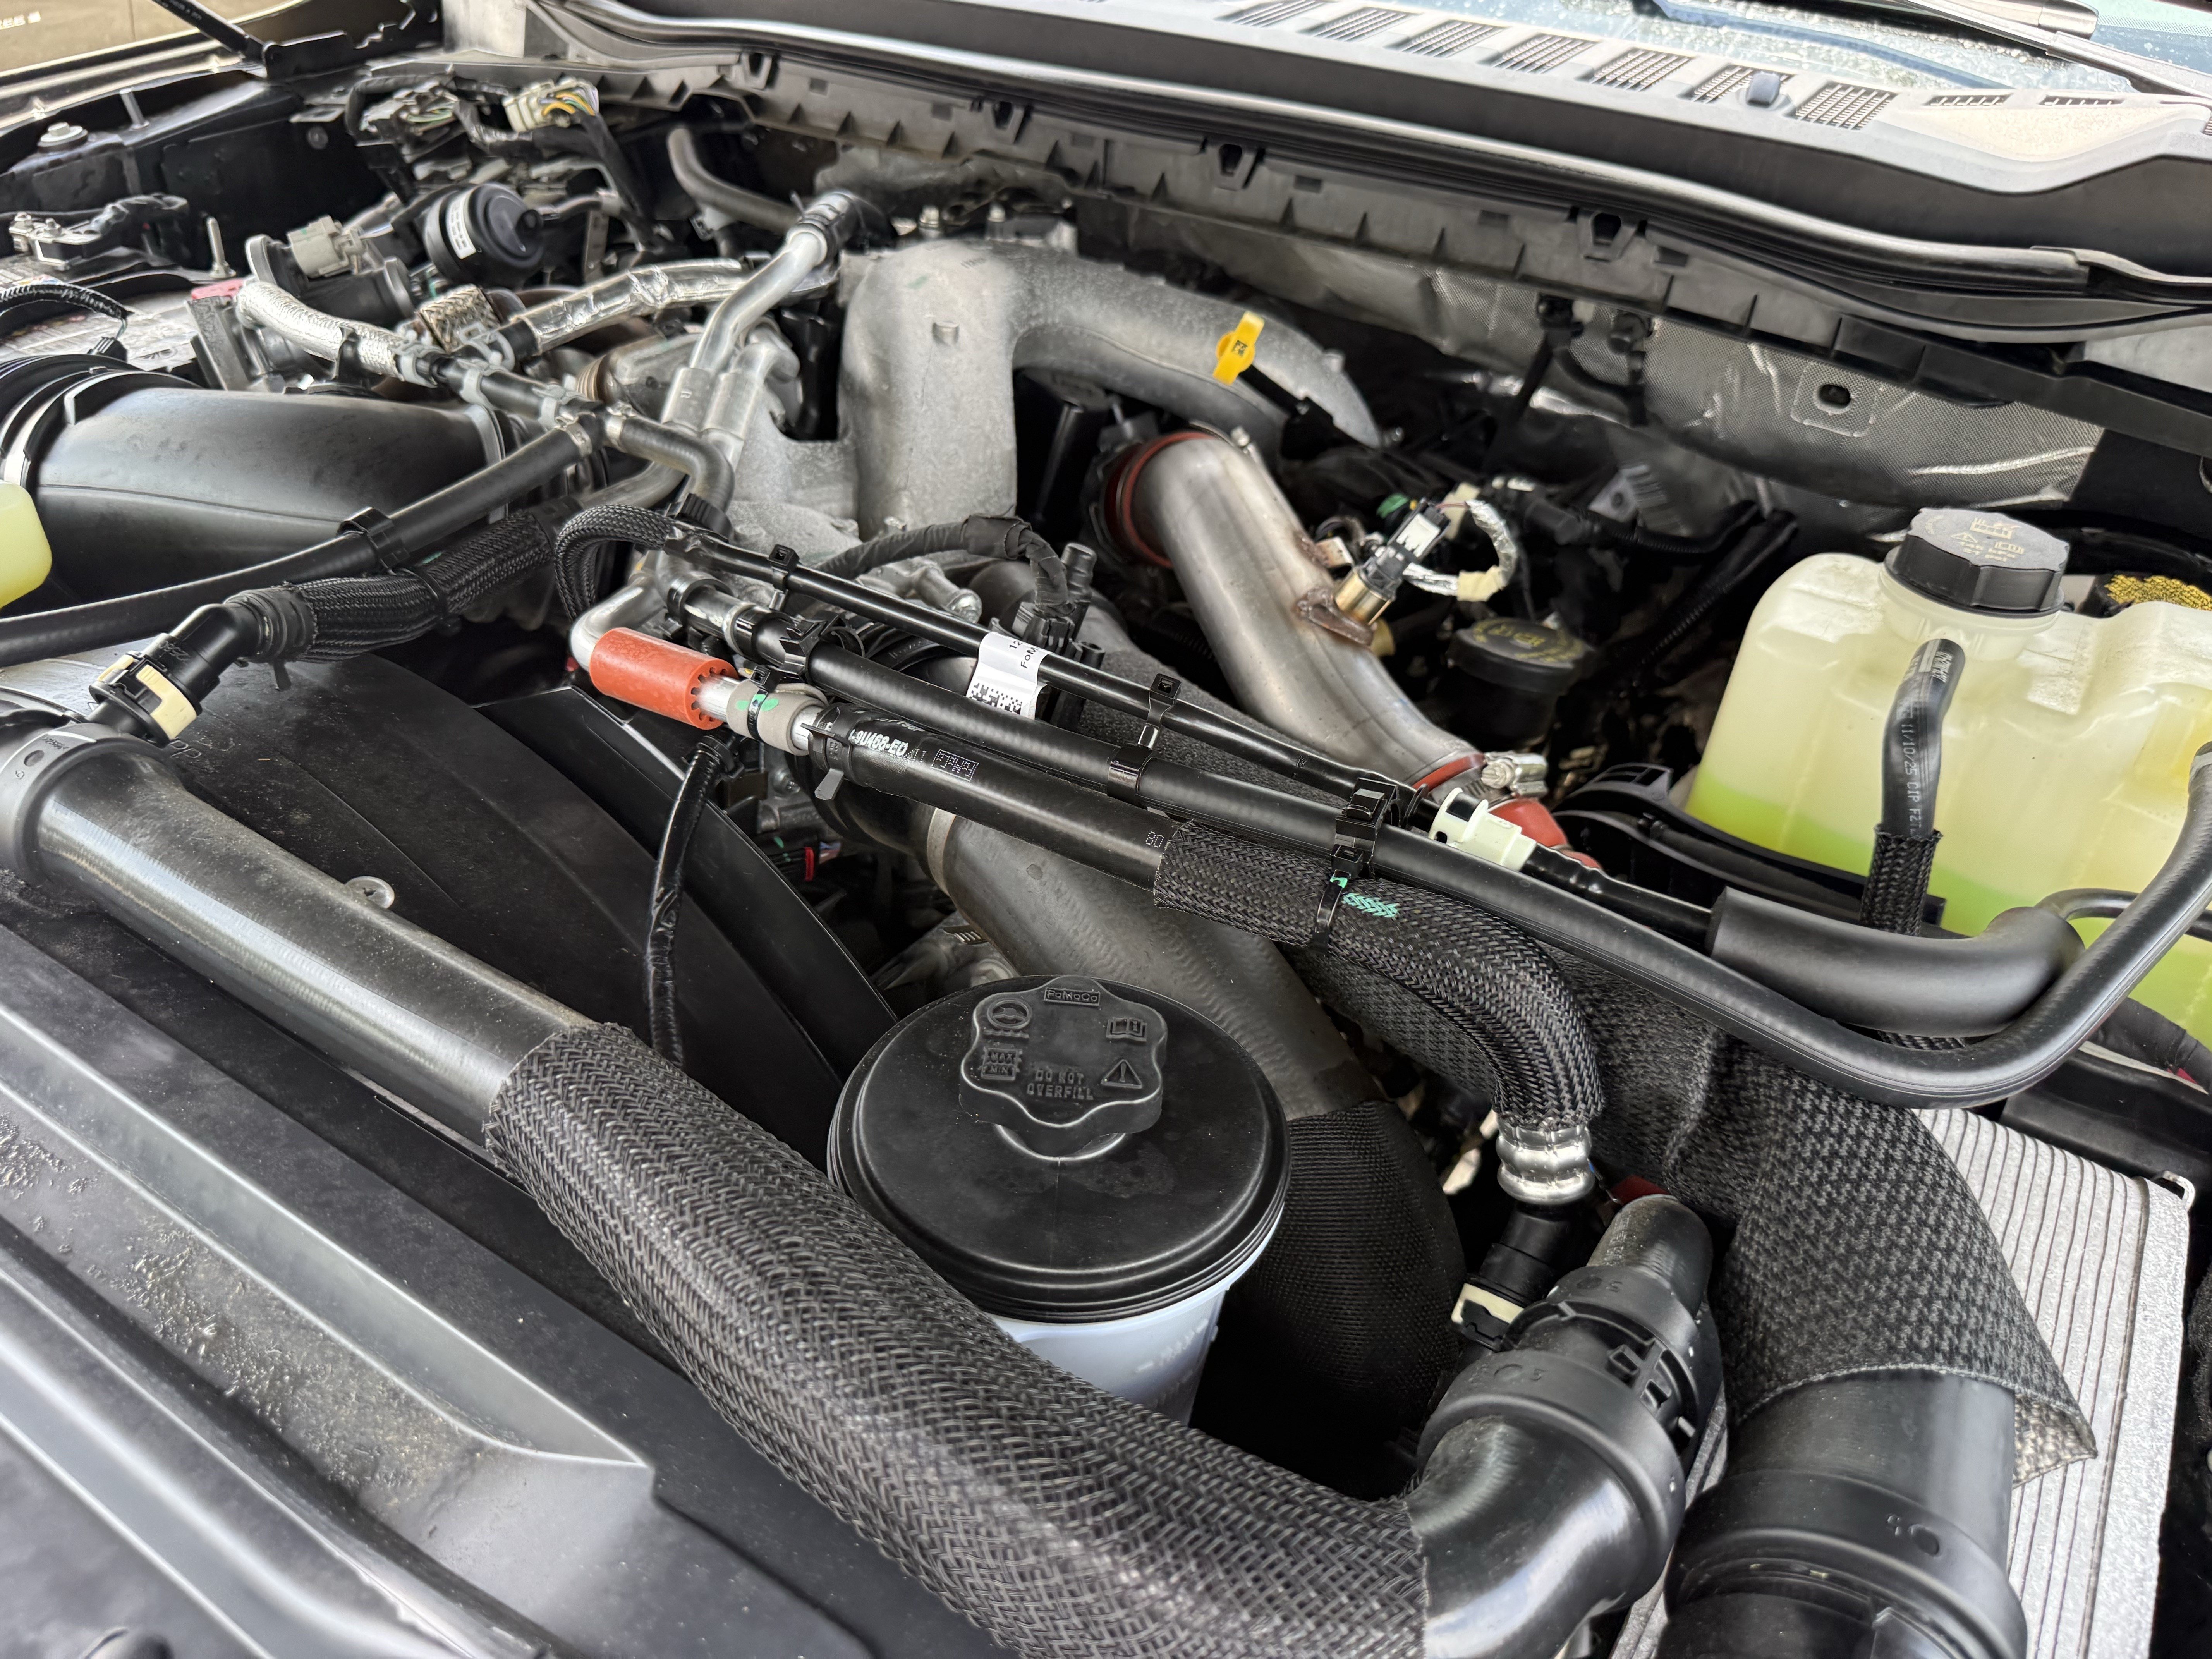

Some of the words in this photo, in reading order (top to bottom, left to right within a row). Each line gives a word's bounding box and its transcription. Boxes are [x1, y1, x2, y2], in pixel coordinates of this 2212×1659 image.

[990, 1051, 1013, 1064] MAX
[990, 1065, 1008, 1075] MIN
[1035, 1069, 1053, 1082] DO
[1058, 1071, 1084, 1085] NOT
[1027, 1082, 1094, 1101] OVERFILL
